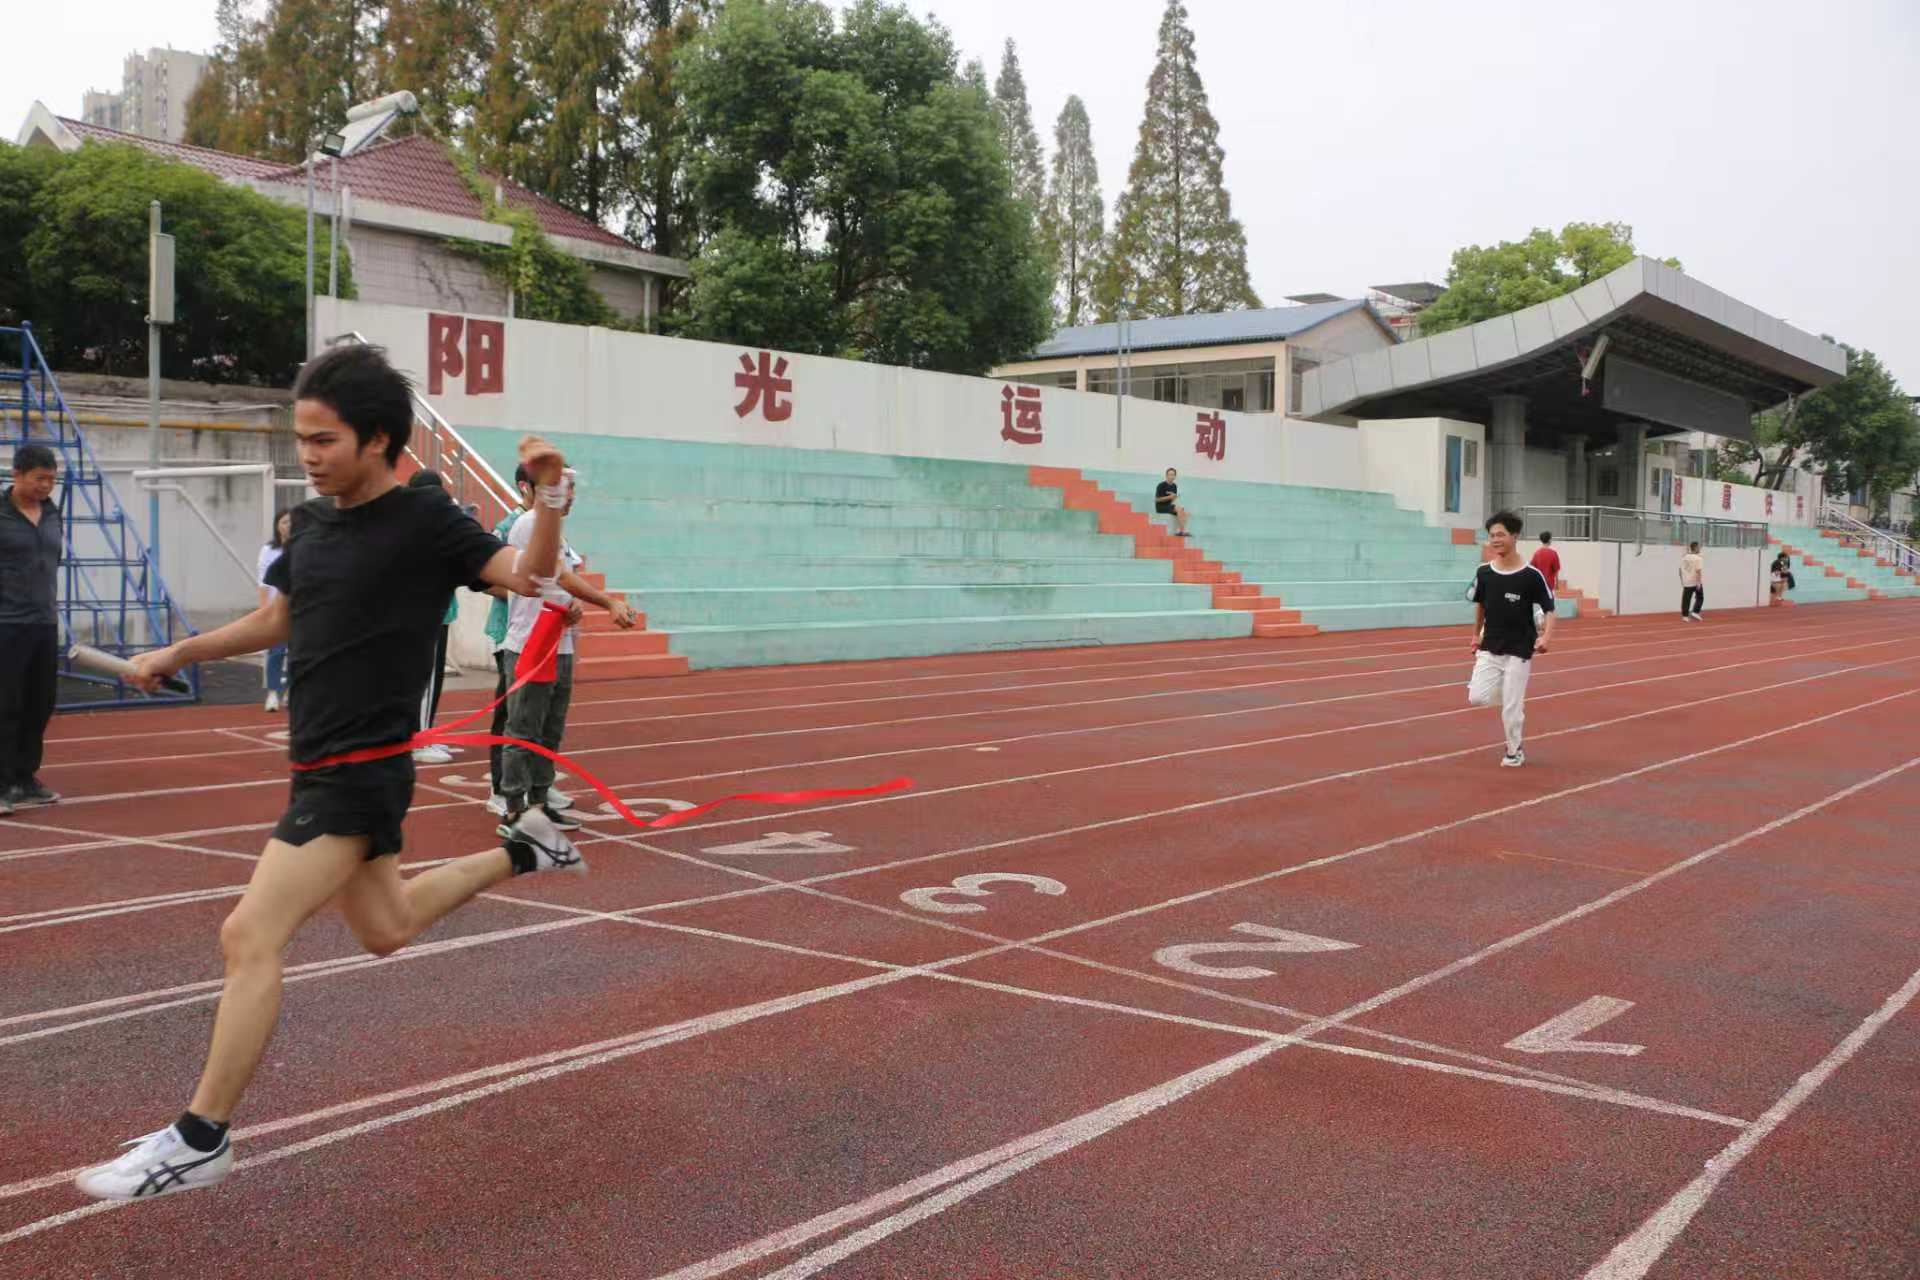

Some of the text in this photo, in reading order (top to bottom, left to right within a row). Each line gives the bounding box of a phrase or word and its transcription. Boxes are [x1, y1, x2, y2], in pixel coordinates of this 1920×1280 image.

[427, 311, 1227, 463] 阳光运动
[701, 830, 857, 855] 4
[900, 872, 1068, 915] 3
[1152, 921, 1361, 979] 2
[1503, 995, 1648, 1057] 1
